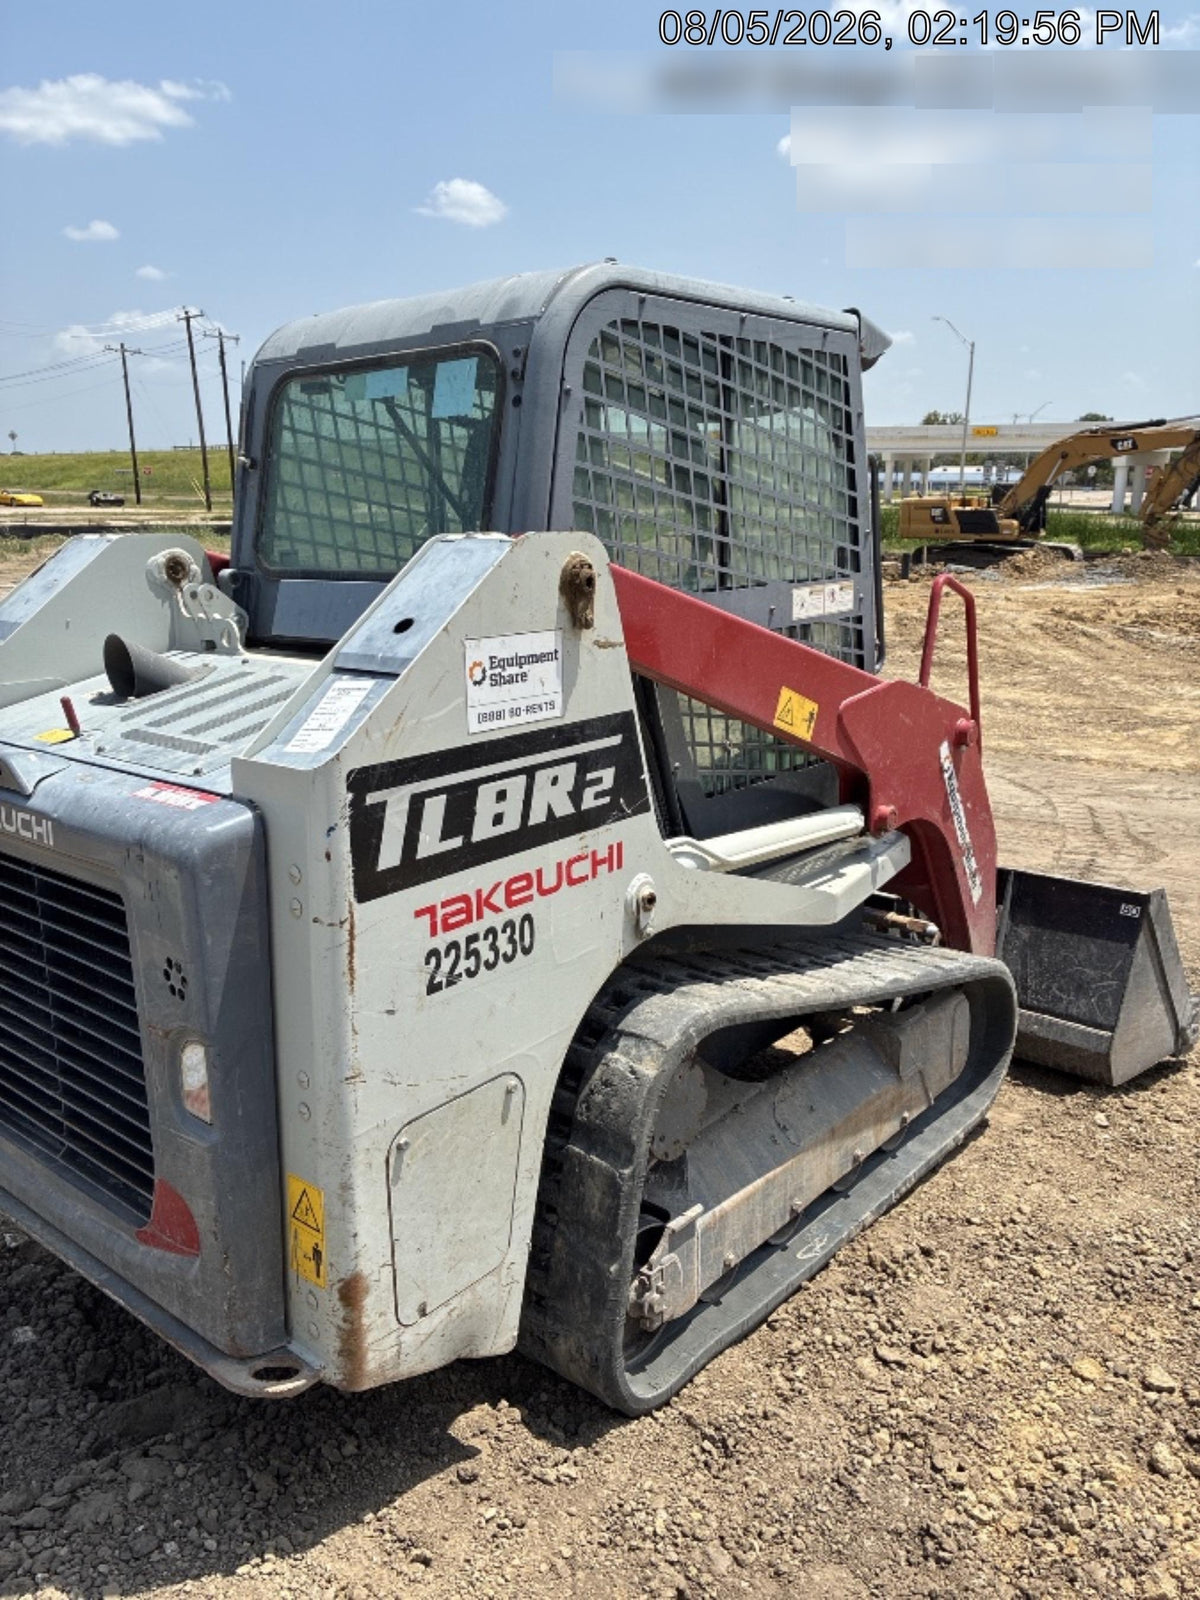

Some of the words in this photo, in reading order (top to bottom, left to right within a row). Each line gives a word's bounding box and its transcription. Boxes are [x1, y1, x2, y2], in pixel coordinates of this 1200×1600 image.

[488, 648, 559, 671] Equipment
[489, 671, 529, 687] Share
[365, 733, 624, 873] TL8R2
[0, 805, 54, 847] UCHI
[424, 912, 535, 996] 225330
